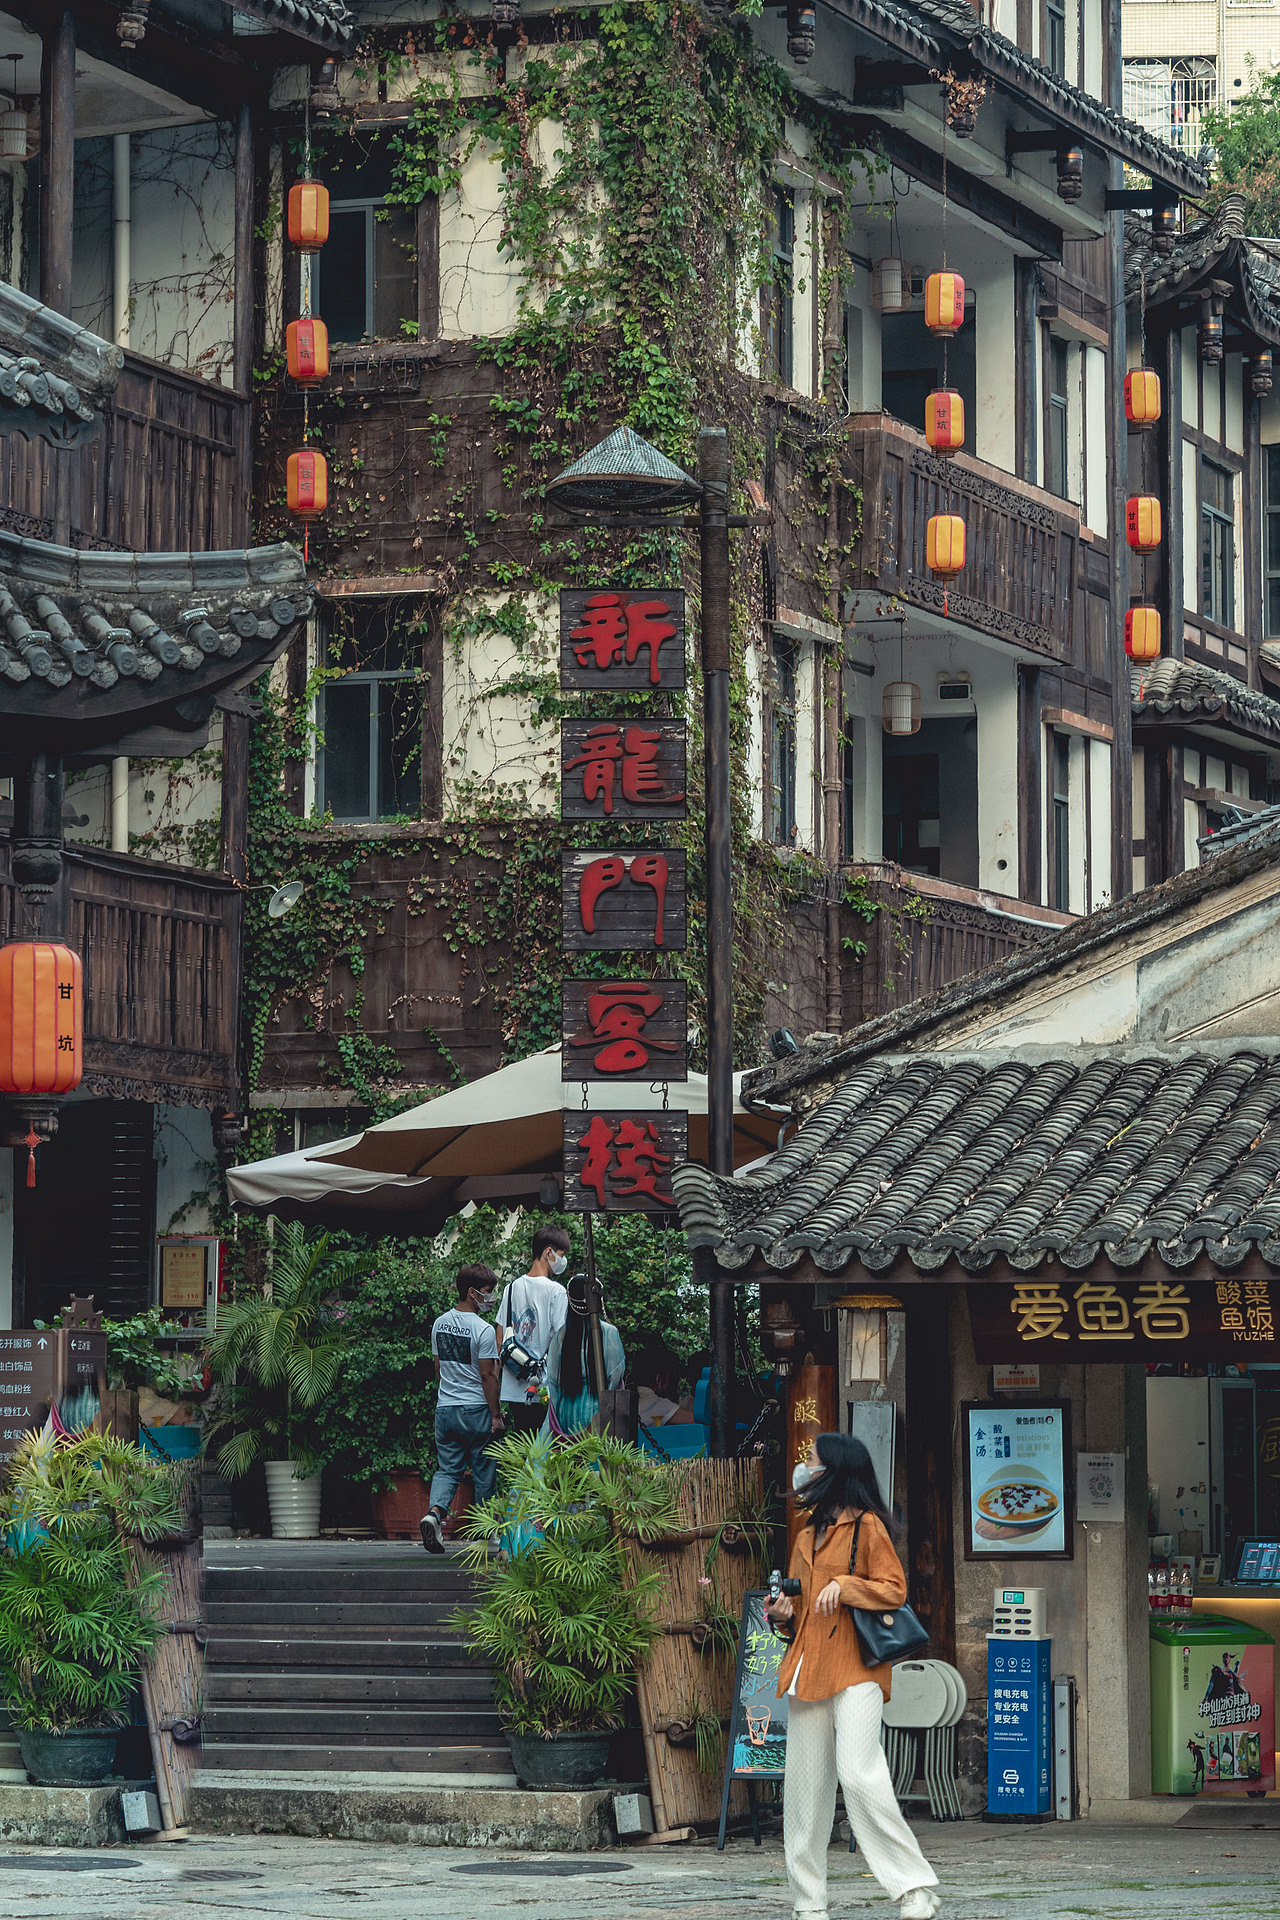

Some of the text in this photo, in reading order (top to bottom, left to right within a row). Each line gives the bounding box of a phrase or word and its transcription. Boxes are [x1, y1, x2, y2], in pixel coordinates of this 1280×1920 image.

[299, 336, 310, 358] 甘坑
[937, 408, 947, 429] 甘坑
[300, 469, 311, 491] 甘坑
[1128, 512, 1136, 531] 甘坑
[58, 983, 74, 1051] 甘坑
[1215, 1280, 1270, 1304] 酸菜
[1010, 1281, 1191, 1340] 爱鱼者
[1220, 1306, 1274, 1330] 鱼饭
[1233, 1332, 1275, 1341] IYUZHE
[975, 1427, 987, 1457] 金汤
[993, 1424, 1003, 1458] 酸菜鱼
[994, 1689, 1029, 1699] 搜电充电
[994, 1702, 1029, 1712] 专业充电
[1210, 1703, 1260, 1727] 好吃到封神
[994, 1714, 1020, 1724] 更安全
